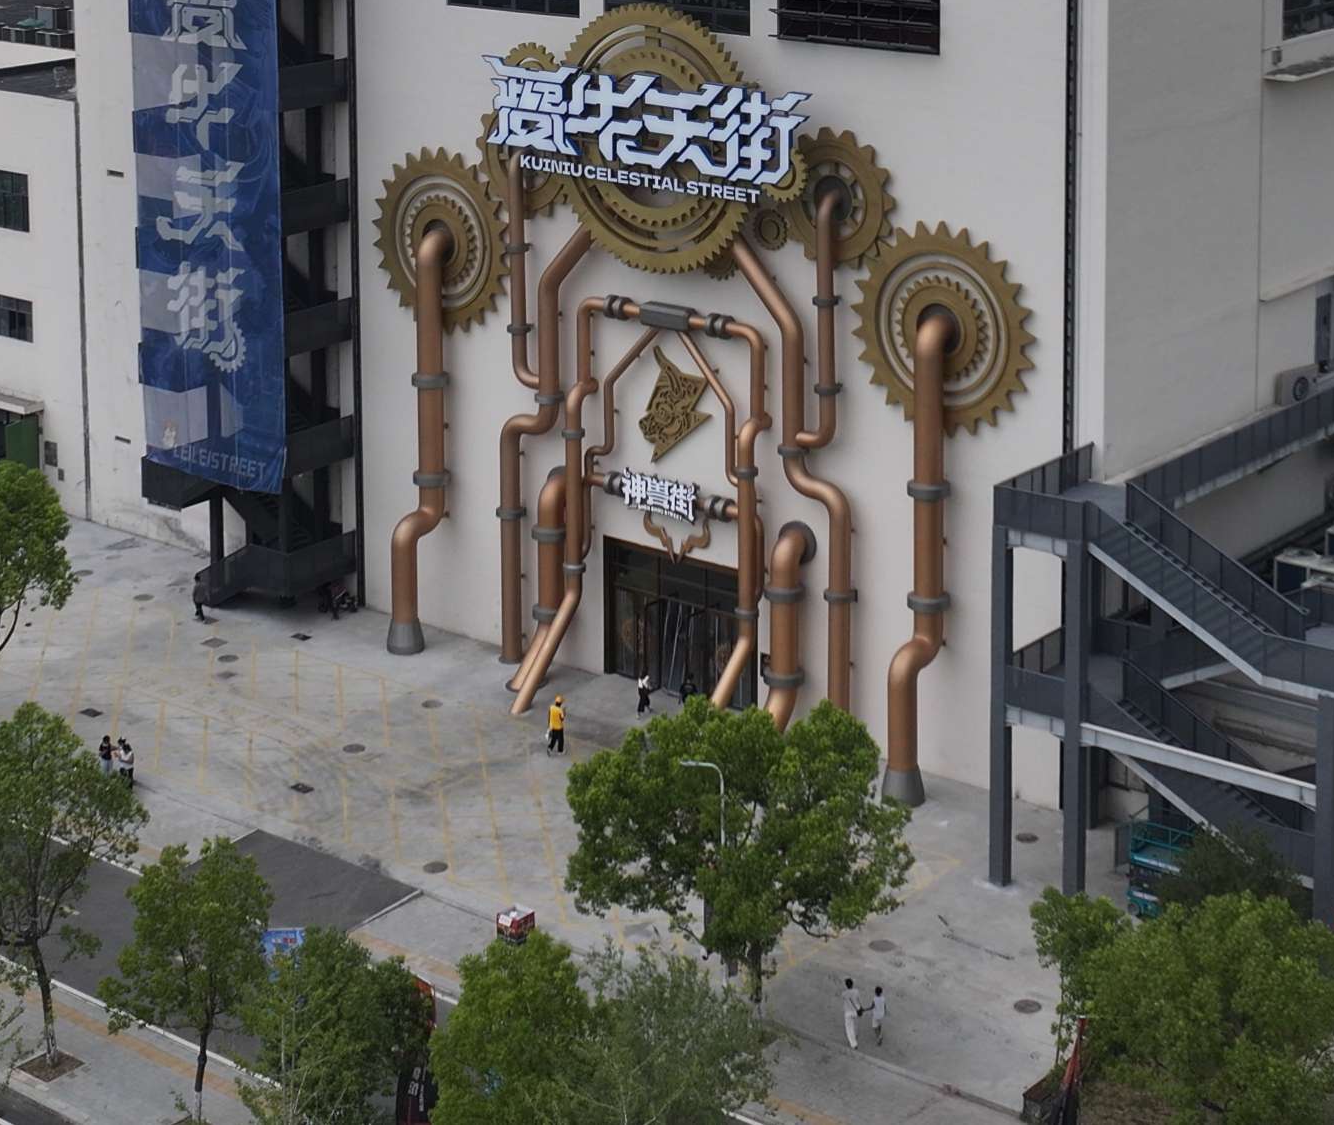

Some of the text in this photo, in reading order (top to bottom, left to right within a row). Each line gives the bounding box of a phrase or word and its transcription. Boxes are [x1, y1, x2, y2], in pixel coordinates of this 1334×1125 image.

[519, 154, 761, 205] KUINIU CELESTIAL STREET
